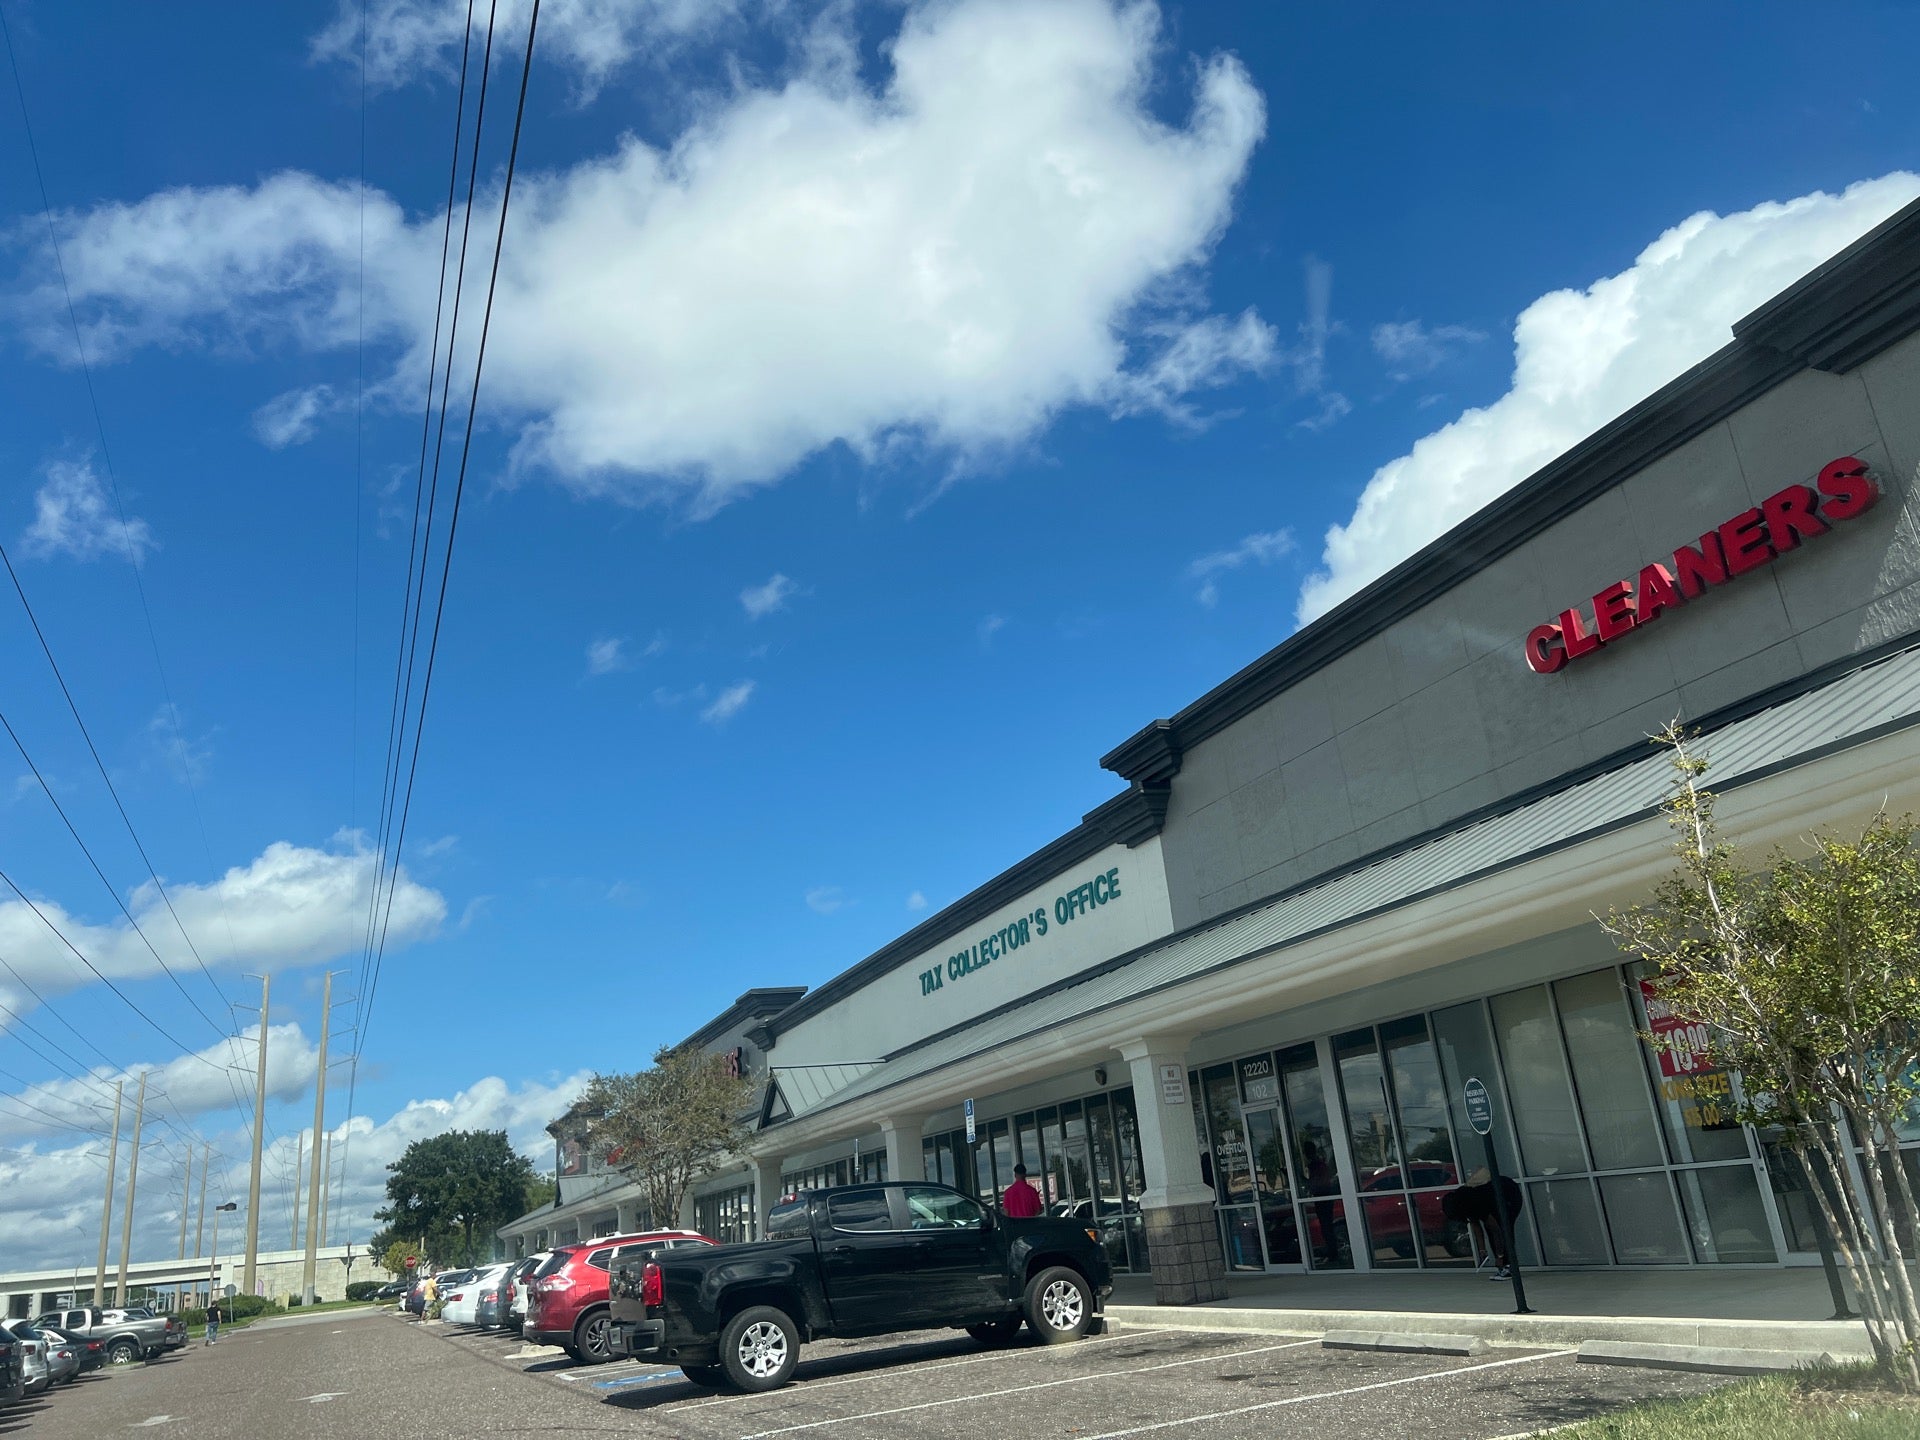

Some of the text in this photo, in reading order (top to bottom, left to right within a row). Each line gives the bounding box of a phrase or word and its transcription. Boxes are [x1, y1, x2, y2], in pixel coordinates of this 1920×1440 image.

[1525, 456, 1879, 674] CLEANERS
[918, 867, 1121, 996] TAX COLLECTOR'S OFFICE
[1243, 1060, 1269, 1077] 12220
[1252, 1084, 1268, 1099] 102
